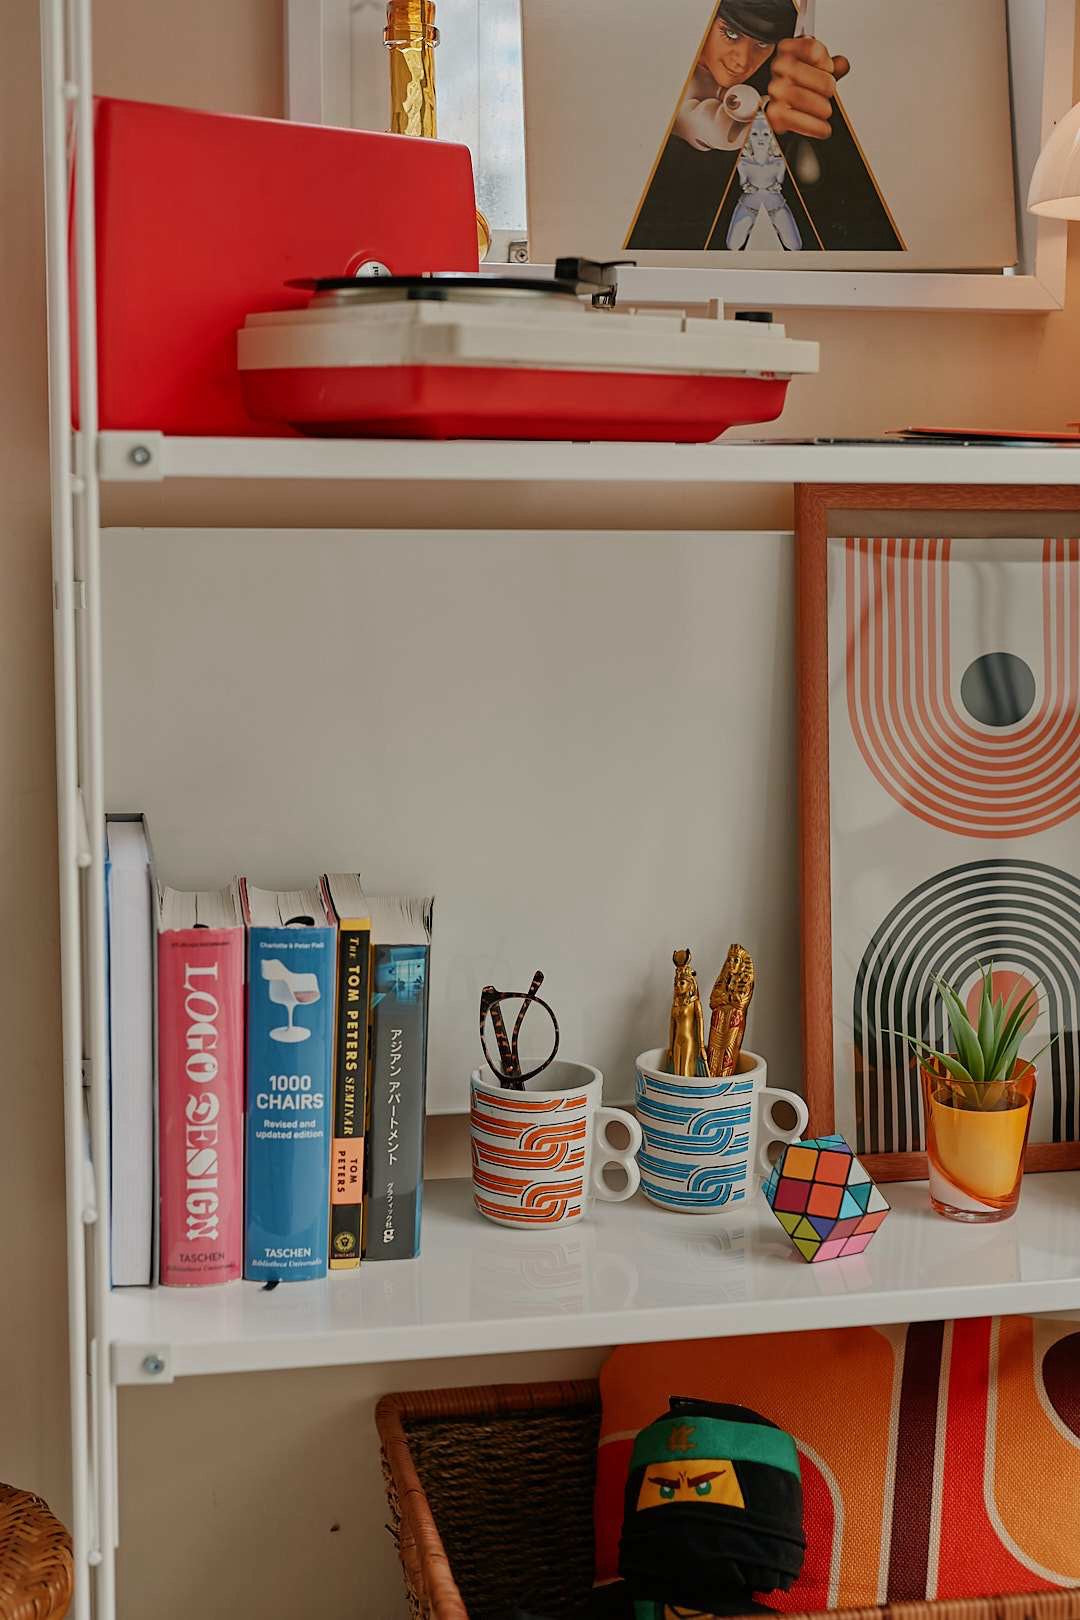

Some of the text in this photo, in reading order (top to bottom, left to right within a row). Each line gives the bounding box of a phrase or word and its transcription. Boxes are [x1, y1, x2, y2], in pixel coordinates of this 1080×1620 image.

[347, 965, 360, 1002] TOM
[183, 961, 220, 1083] LOGO
[345, 1010, 359, 1071] PETERS
[389, 1029, 403, 1077] アジアン
[269, 1074, 312, 1092] 1000
[256, 1092, 324, 1110] CHAIRS
[343, 1075, 355, 1136] SEMINAR
[255, 1130, 324, 1140] updated edition
[263, 1119, 316, 1129] Revised and
[184, 1091, 221, 1241] DESIGN
[337, 1150, 346, 1193] PETERS
[350, 1158, 358, 1184] TOM
[179, 1252, 225, 1263] TASCHEN
[264, 1247, 312, 1258] TASCHEN
